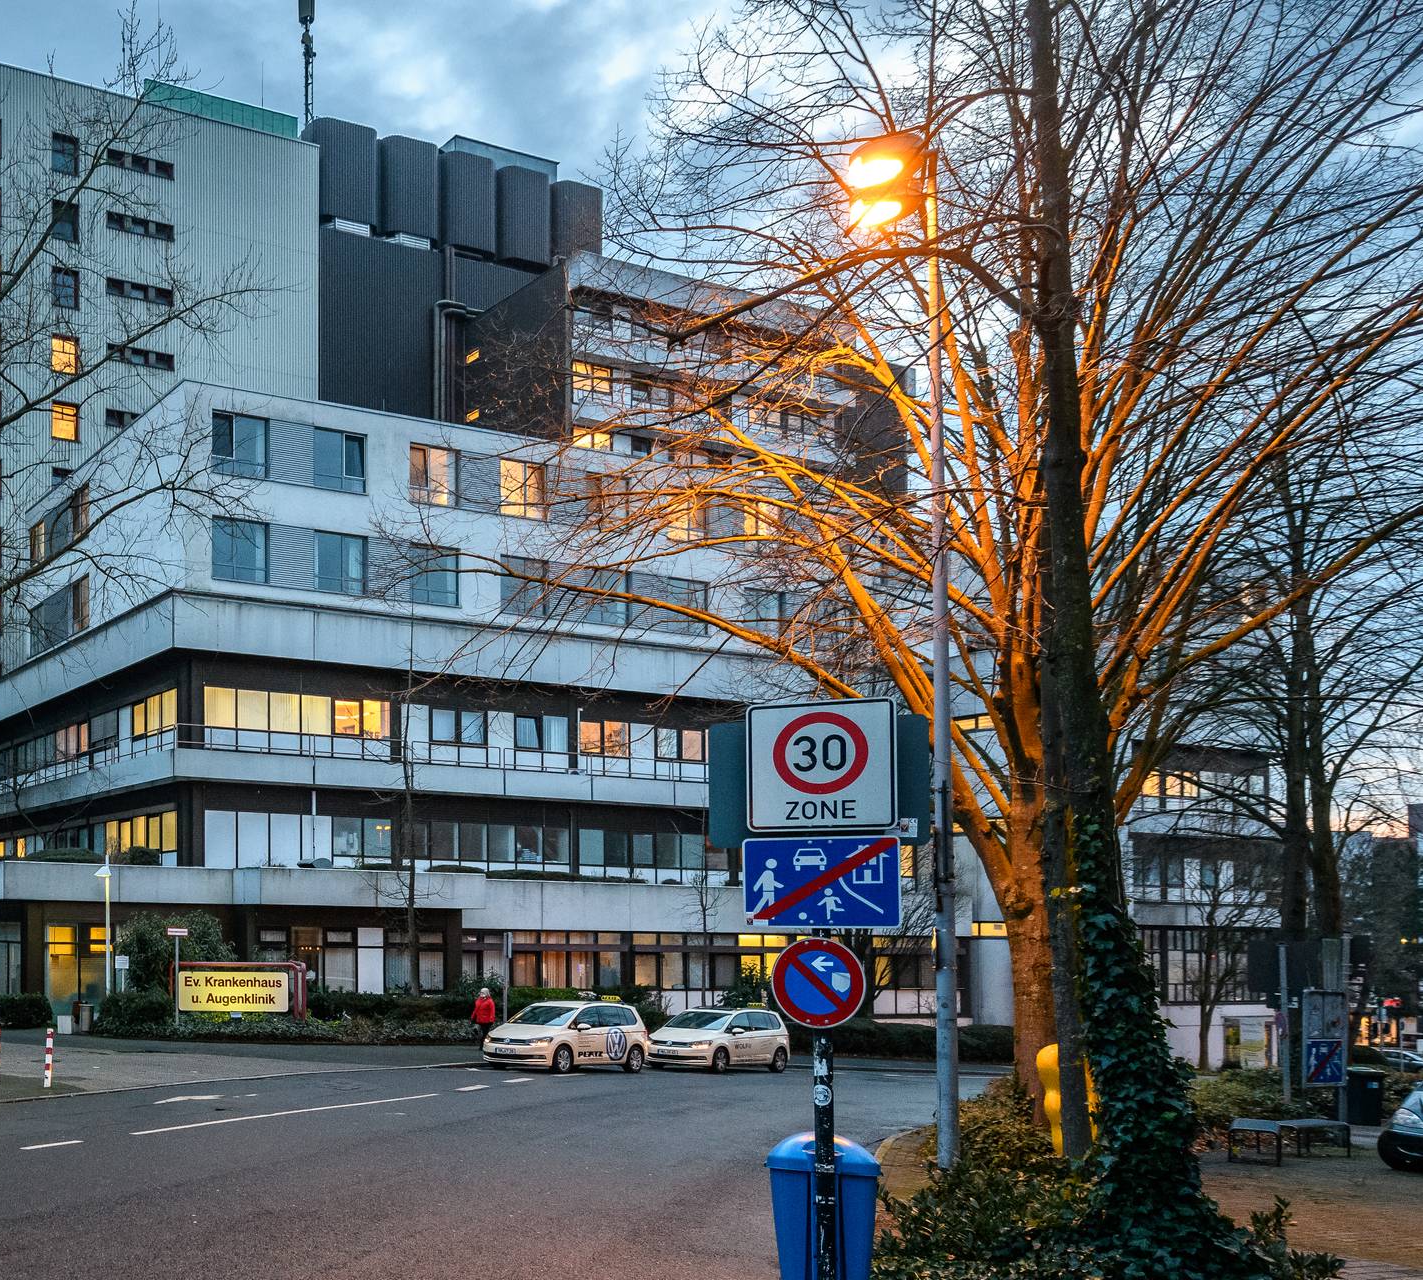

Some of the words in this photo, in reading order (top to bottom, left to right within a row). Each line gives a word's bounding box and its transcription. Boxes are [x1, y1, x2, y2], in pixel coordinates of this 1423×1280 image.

[792, 734, 847, 772] 30
[785, 799, 857, 821] ZONE
[184, 976, 201, 987] Ev.
[204, 976, 283, 988] Krankenhaus
[191, 995, 202, 1004] u.
[205, 993, 276, 1006] Augenklinik
